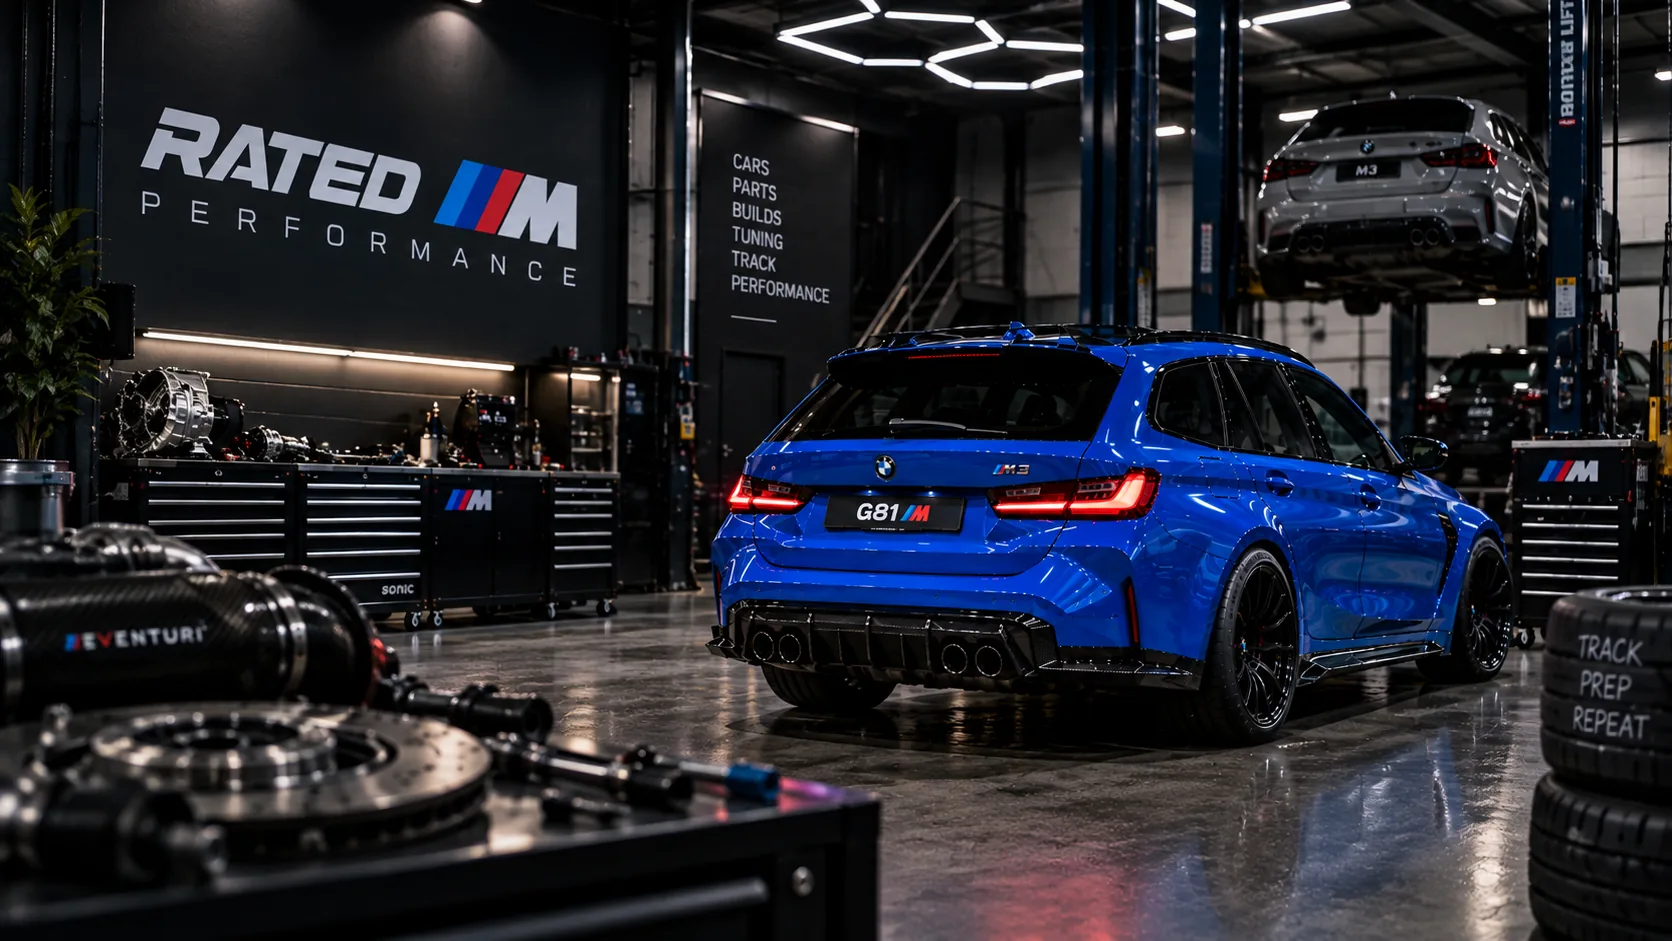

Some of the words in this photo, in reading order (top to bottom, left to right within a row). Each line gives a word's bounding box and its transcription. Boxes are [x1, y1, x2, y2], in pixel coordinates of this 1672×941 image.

[140, 107, 422, 215] RATED
[733, 153, 770, 176] CARS
[1355, 165, 1378, 176] M3
[733, 177, 777, 201] PARTS
[732, 201, 782, 226] BUILDS
[142, 191, 576, 287] PERFORMANCE
[732, 226, 783, 250] TUNING
[732, 250, 776, 272] TRACK
[731, 274, 830, 304] PERFORMANCE
[856, 502, 899, 522] G81
[82, 626, 203, 651] EVENTURI
[1578, 634, 1643, 667] TRACK
[1580, 669, 1632, 700] PREP
[1573, 705, 1651, 740] REPEAT
